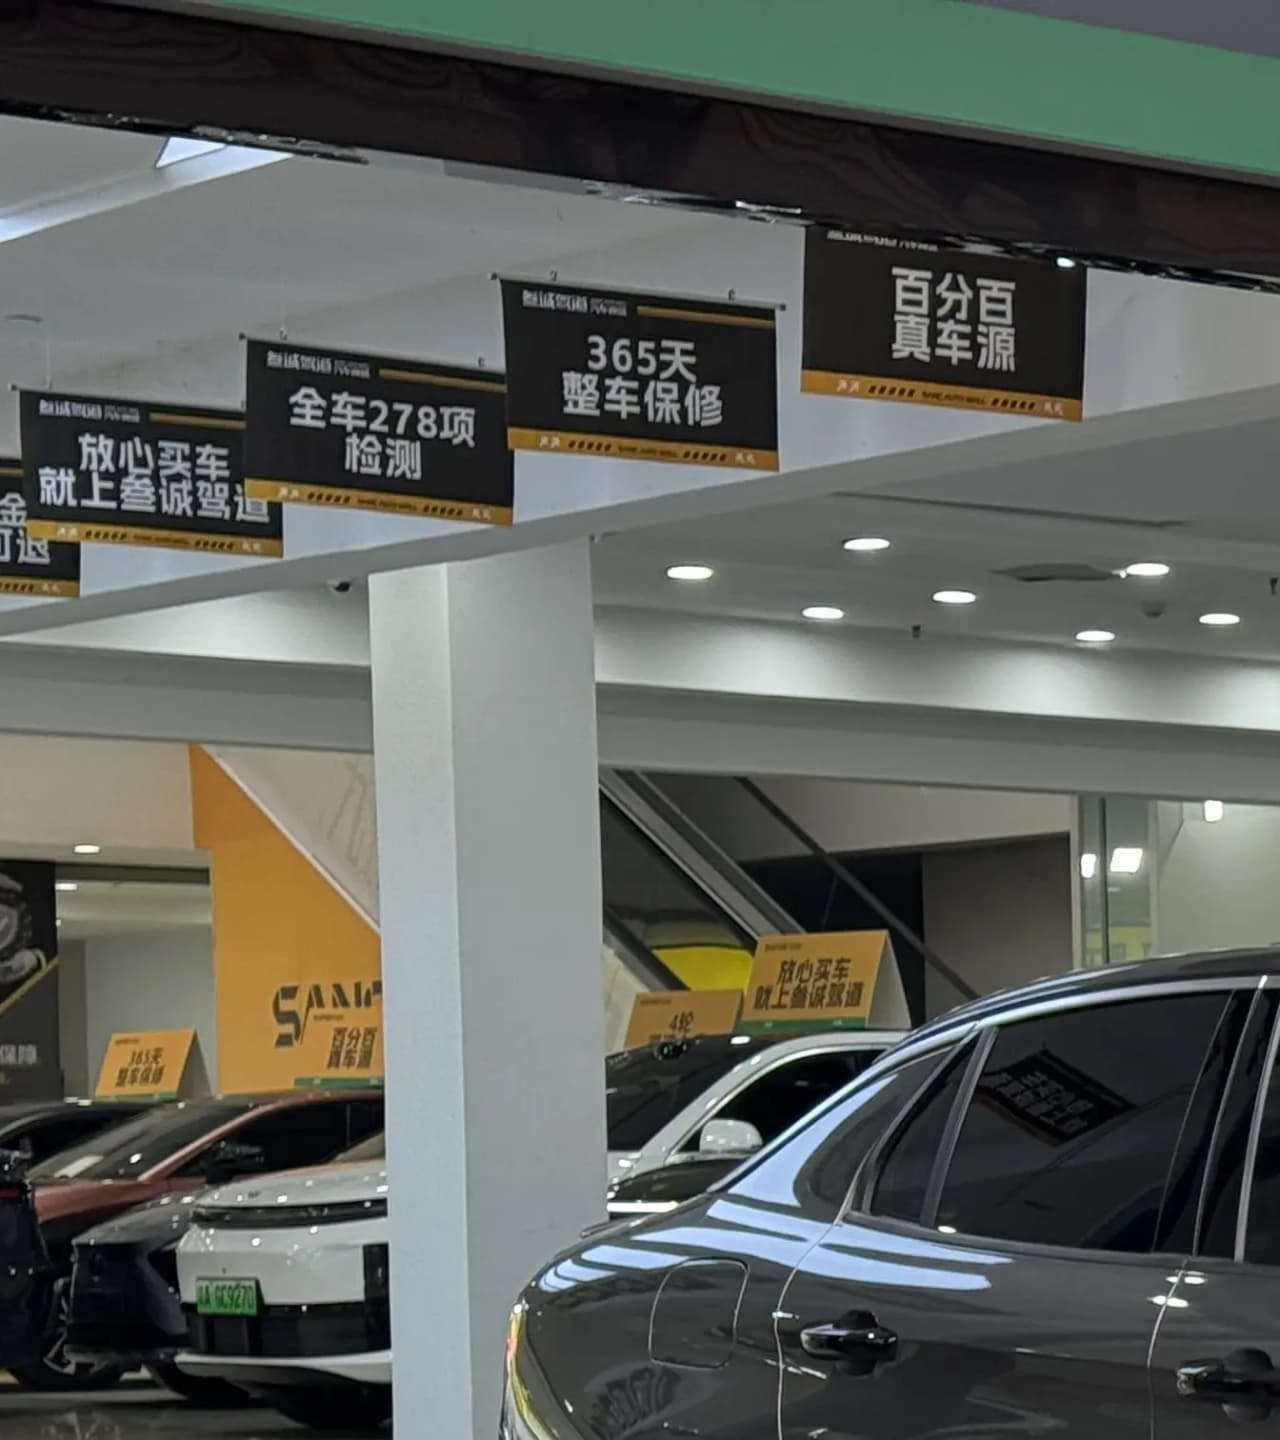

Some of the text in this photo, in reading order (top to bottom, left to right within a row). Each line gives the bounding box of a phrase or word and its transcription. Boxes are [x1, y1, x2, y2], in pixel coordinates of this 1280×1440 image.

[891, 267, 1016, 325] 百分百
[587, 335, 697, 382] 365天
[892, 314, 1016, 372] 真车源
[289, 386, 476, 448] 全车278项
[562, 371, 723, 427] 整车保修
[78, 432, 230, 481] 放心买车
[344, 435, 422, 481] 检测
[38, 466, 270, 523] 就上叁诚驾道
[776, 957, 853, 986] 放心买车
